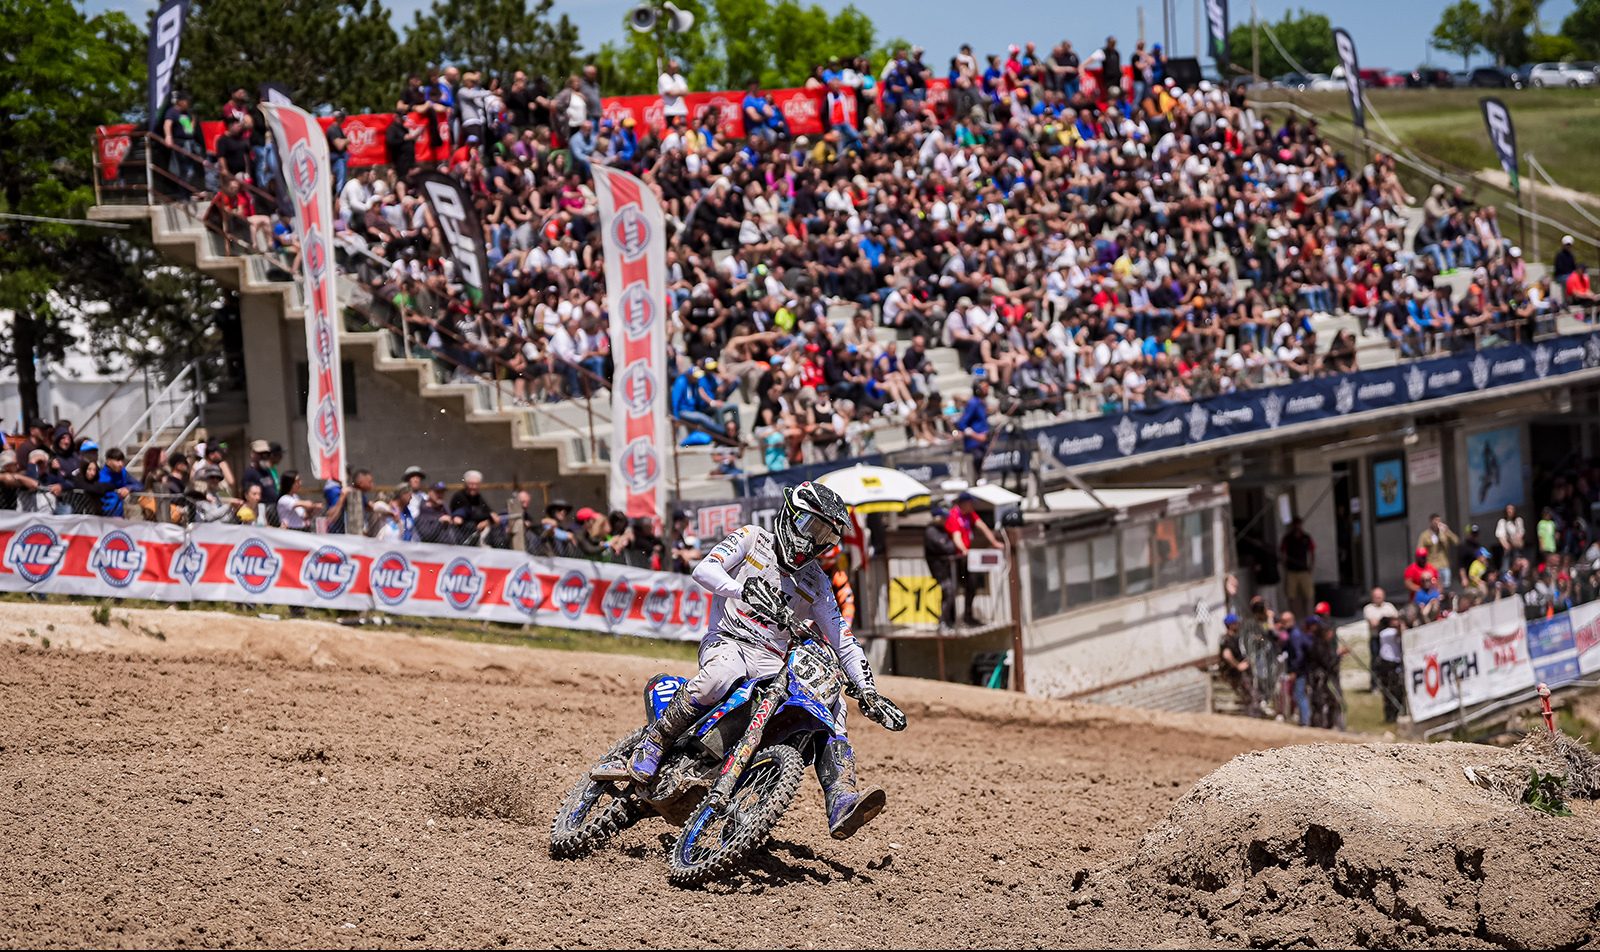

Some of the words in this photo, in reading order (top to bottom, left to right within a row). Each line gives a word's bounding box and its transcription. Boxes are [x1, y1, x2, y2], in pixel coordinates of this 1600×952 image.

[10, 543, 65, 565] NILS
[94, 549, 142, 571] NILS
[231, 556, 279, 577] NILS
[305, 562, 355, 584] NILS
[372, 568, 415, 589] NILS
[441, 573, 482, 594] NILS
[913, 587, 921, 611] 1
